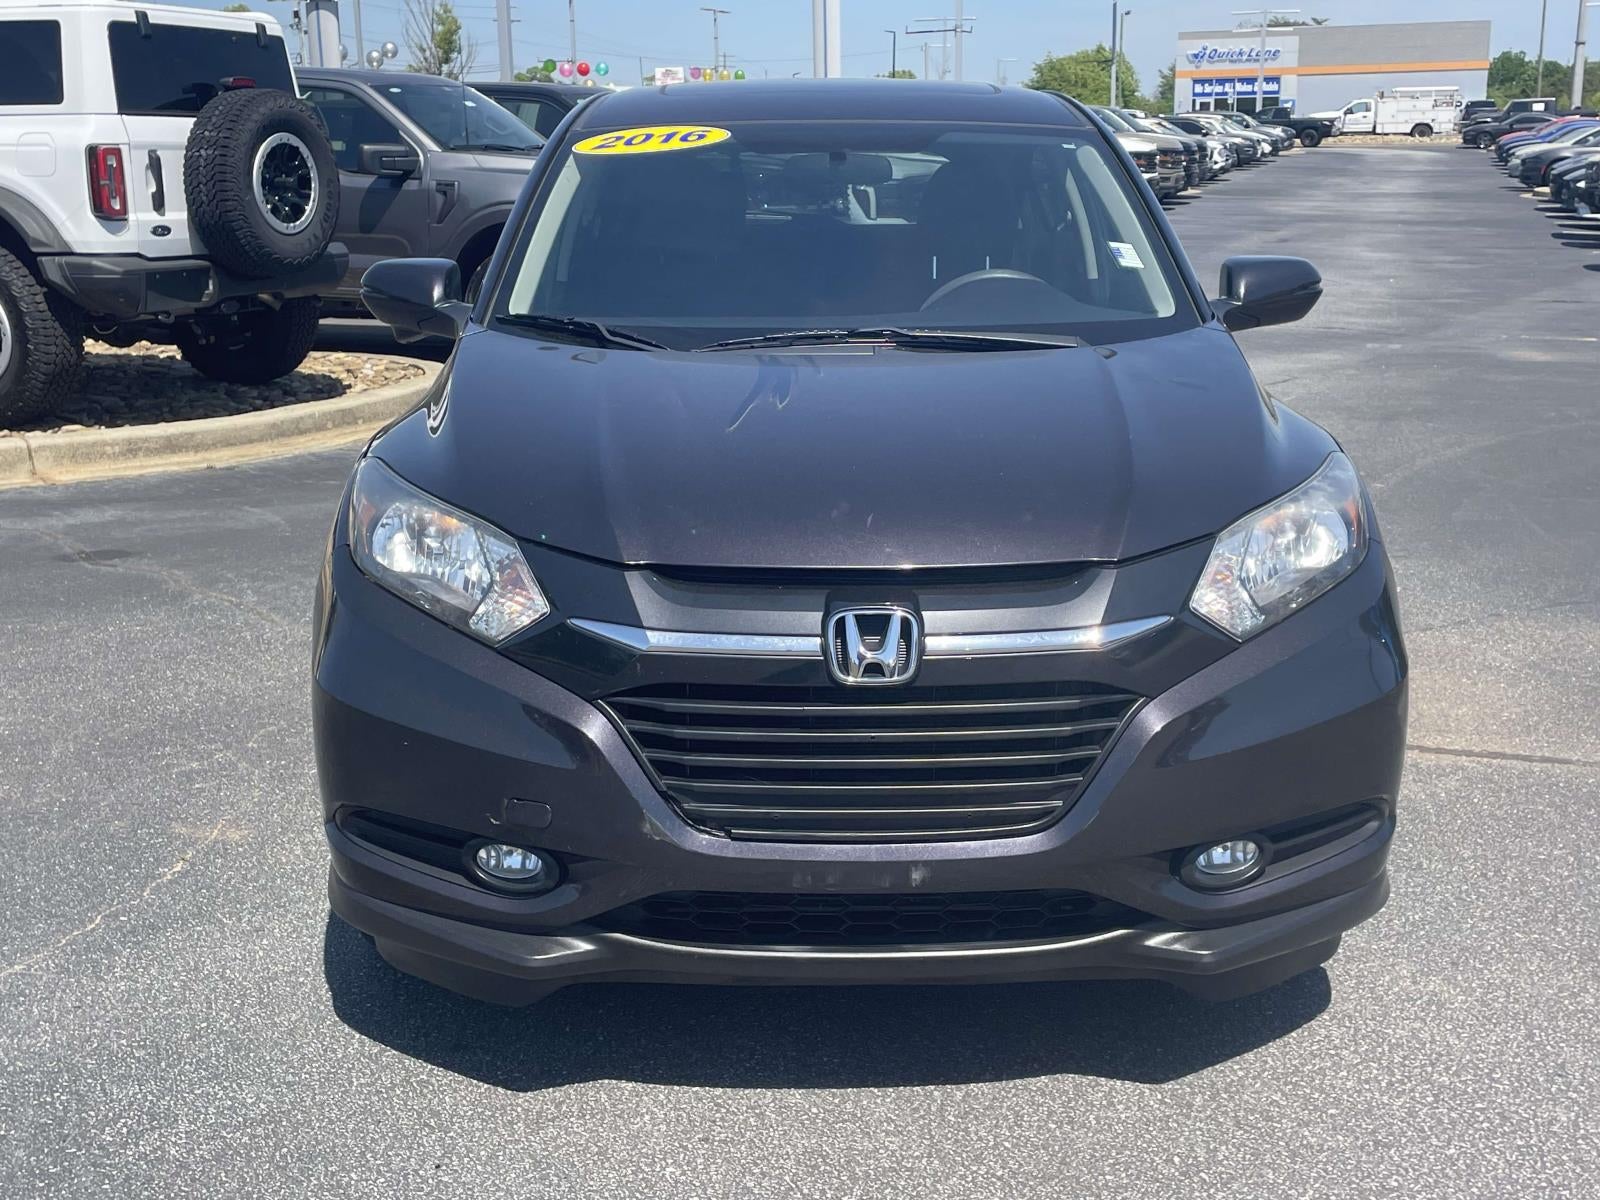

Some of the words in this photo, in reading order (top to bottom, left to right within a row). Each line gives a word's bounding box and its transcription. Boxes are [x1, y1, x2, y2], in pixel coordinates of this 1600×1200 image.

[1208, 47, 1246, 59] Quick
[1247, 47, 1281, 58] Lane
[590, 129, 712, 150] 2016
